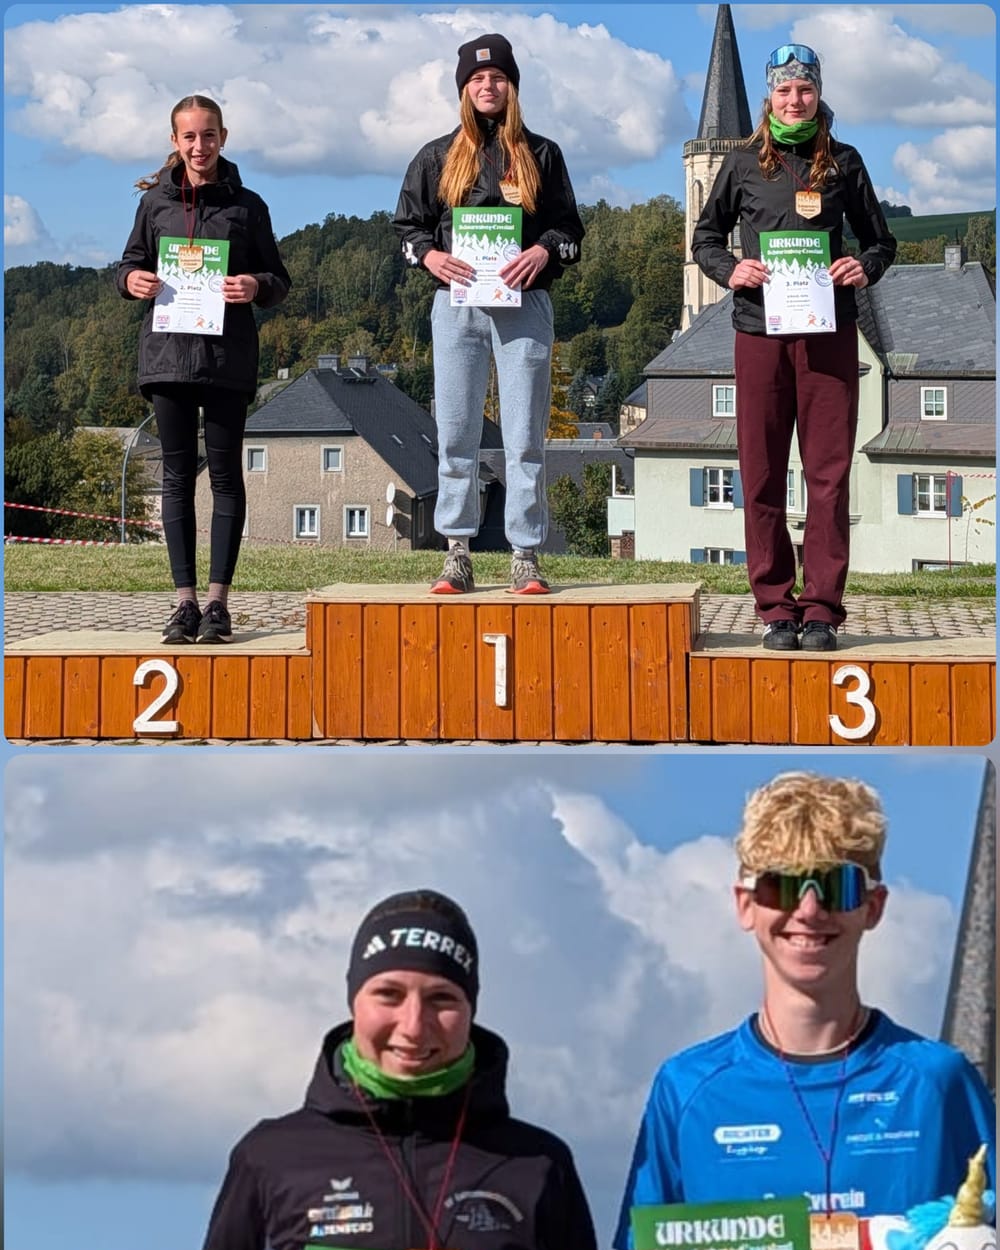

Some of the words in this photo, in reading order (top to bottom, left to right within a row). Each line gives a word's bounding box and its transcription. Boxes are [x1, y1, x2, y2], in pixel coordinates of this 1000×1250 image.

[461, 213, 512, 224] URKUNDE
[769, 237, 821, 248] URKUNDE
[482, 633, 508, 707] 1
[132, 659, 180, 733] 2
[829, 665, 876, 740] 3
[390, 927, 474, 972] TERREX
[656, 1214, 785, 1246] URKUNDE
